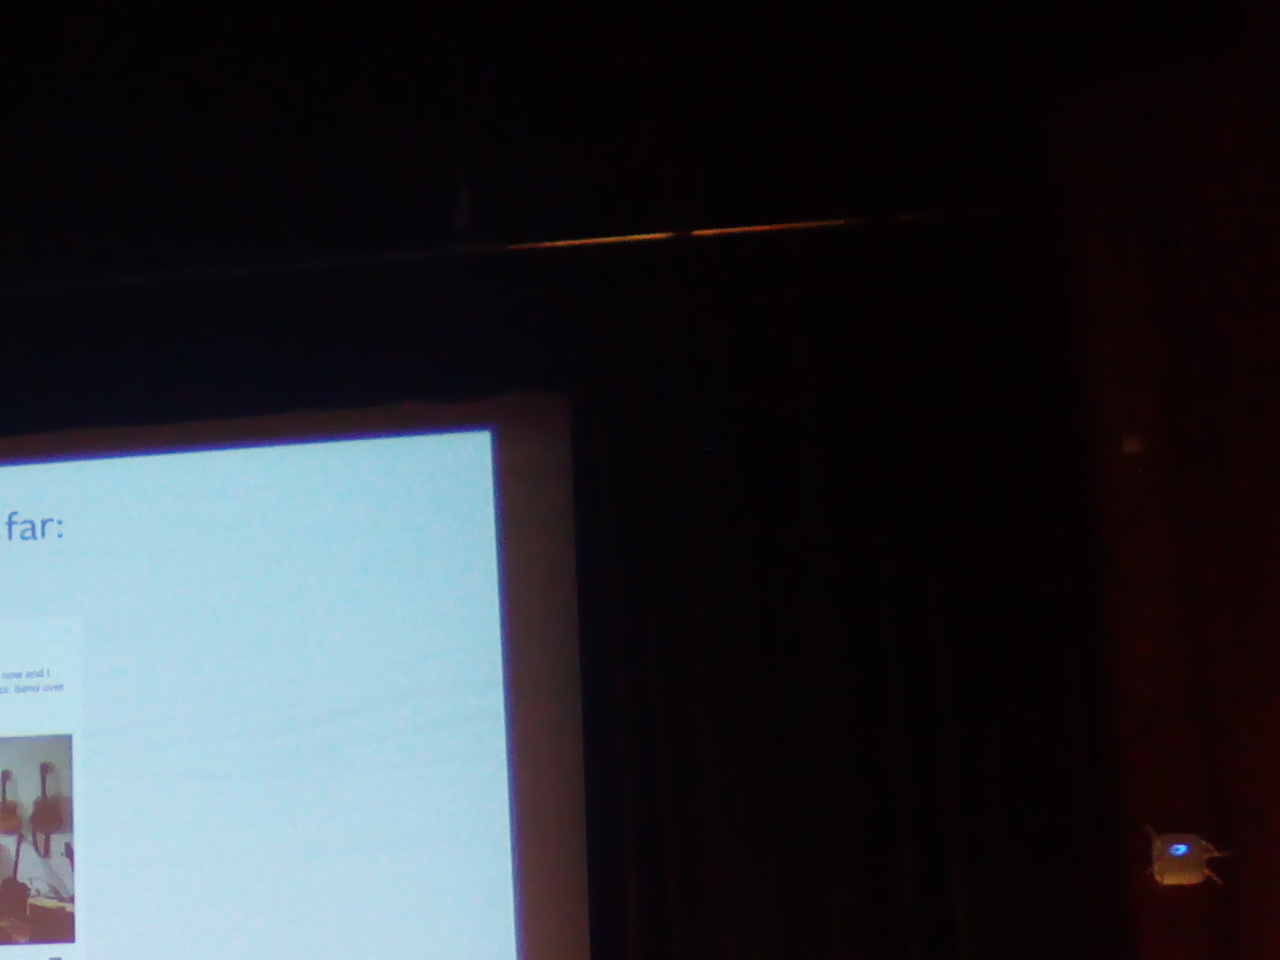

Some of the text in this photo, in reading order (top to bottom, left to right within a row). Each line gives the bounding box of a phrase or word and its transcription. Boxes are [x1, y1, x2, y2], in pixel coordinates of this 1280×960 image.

[5, 510, 64, 541] far:
[2, 672, 22, 680] now
[26, 669, 44, 679] and
[14, 684, 40, 694] Send
[42, 683, 64, 692] over
